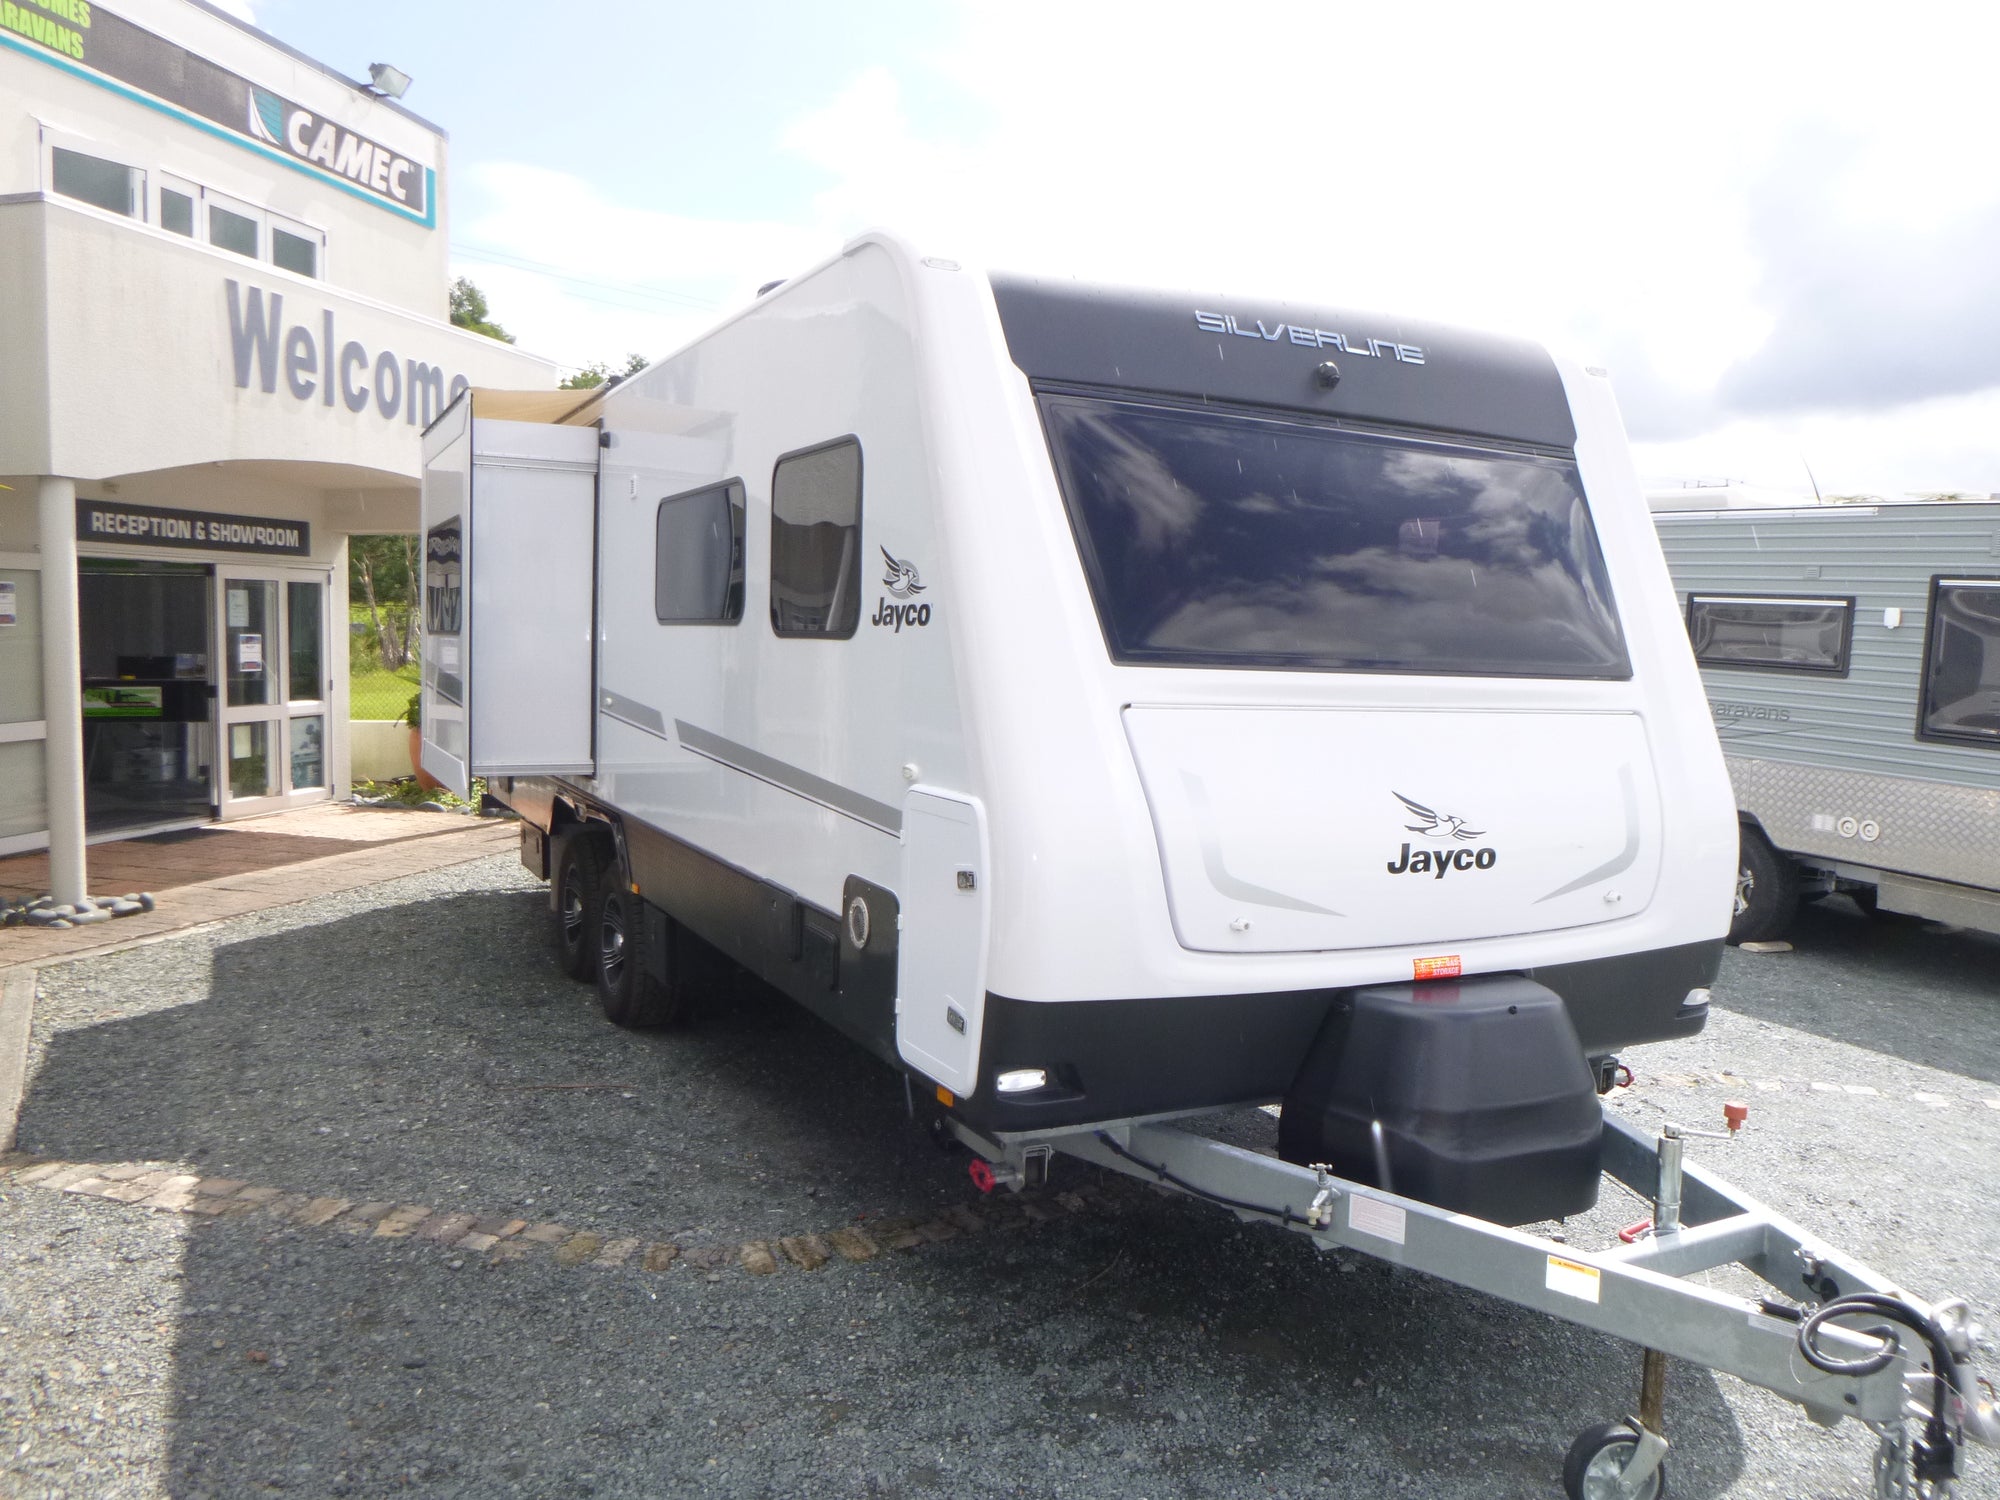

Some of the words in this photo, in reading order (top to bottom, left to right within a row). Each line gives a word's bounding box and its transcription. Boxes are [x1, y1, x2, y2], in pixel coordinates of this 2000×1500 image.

[0, 0, 84, 59] RAVANS
[288, 110, 410, 200] CAMEC
[1195, 310, 1426, 365] SILVERLINE
[91, 511, 191, 539] RECEPTION
[194, 521, 206, 540] &
[210, 522, 299, 547] SHOWROOM
[872, 596, 931, 634] Jayco
[1387, 843, 1497, 880] Jayco
